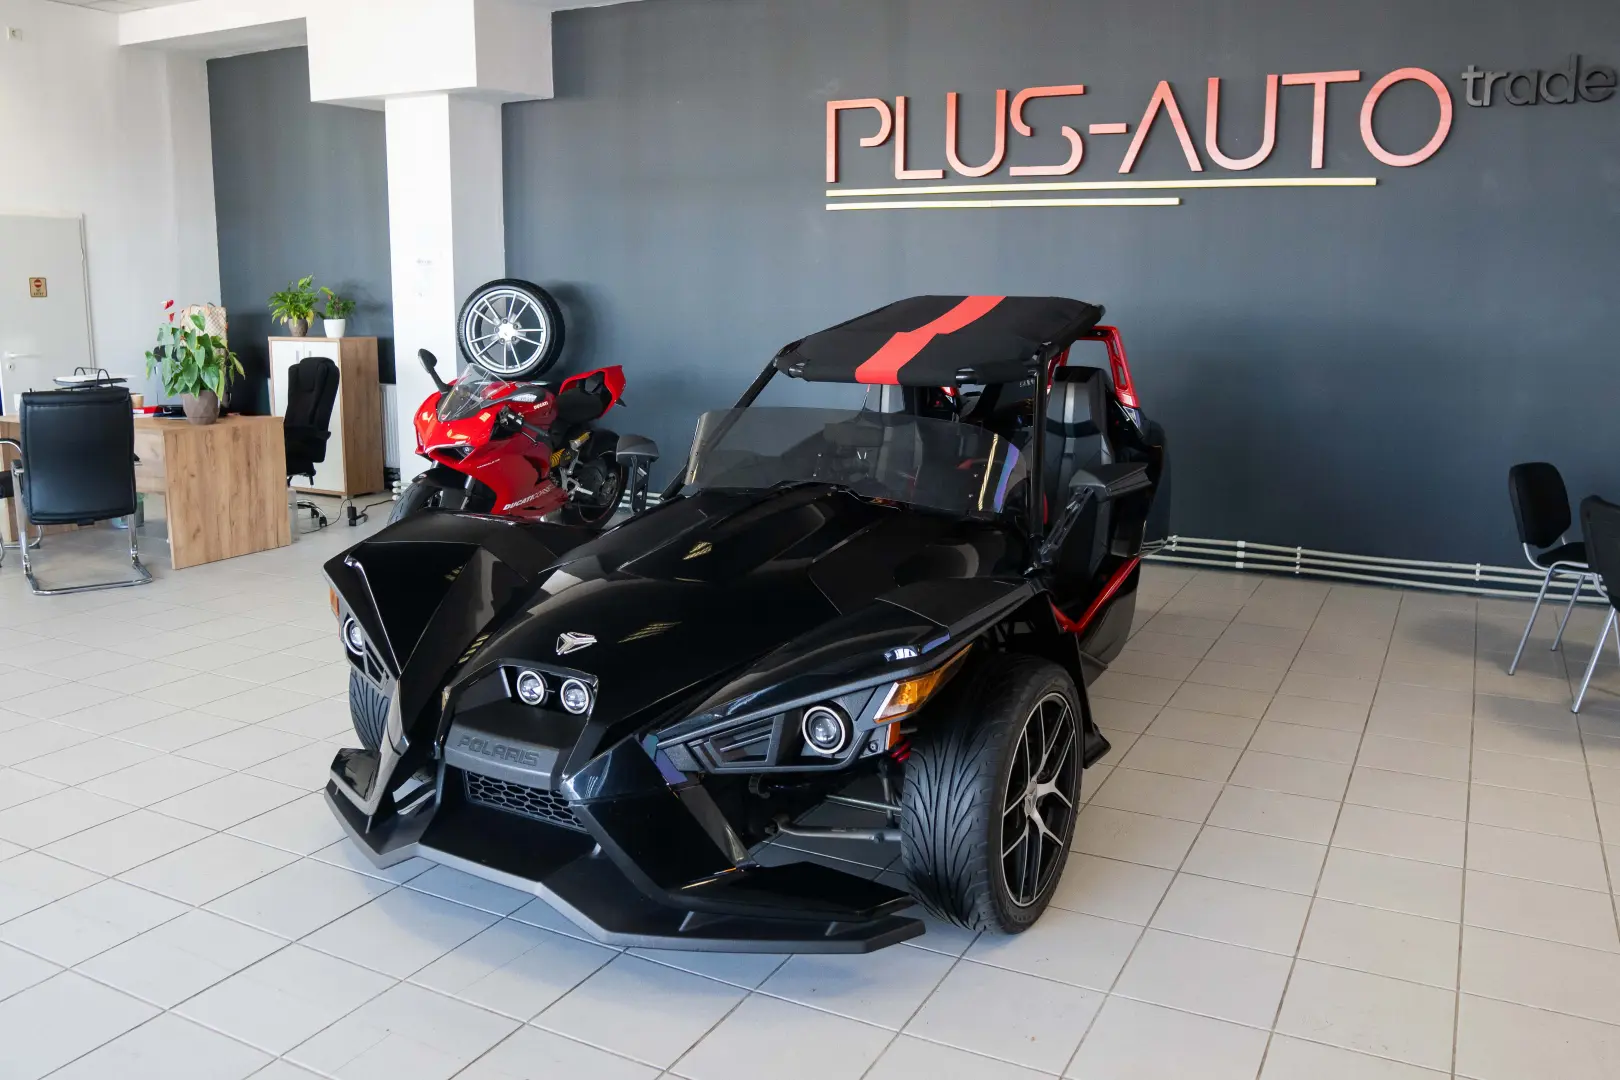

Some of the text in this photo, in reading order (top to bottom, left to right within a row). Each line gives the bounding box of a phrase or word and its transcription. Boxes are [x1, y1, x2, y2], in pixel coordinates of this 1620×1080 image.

[825, 54, 1617, 183] PLUS-AUTO trade
[456, 733, 540, 767] POLARIS
